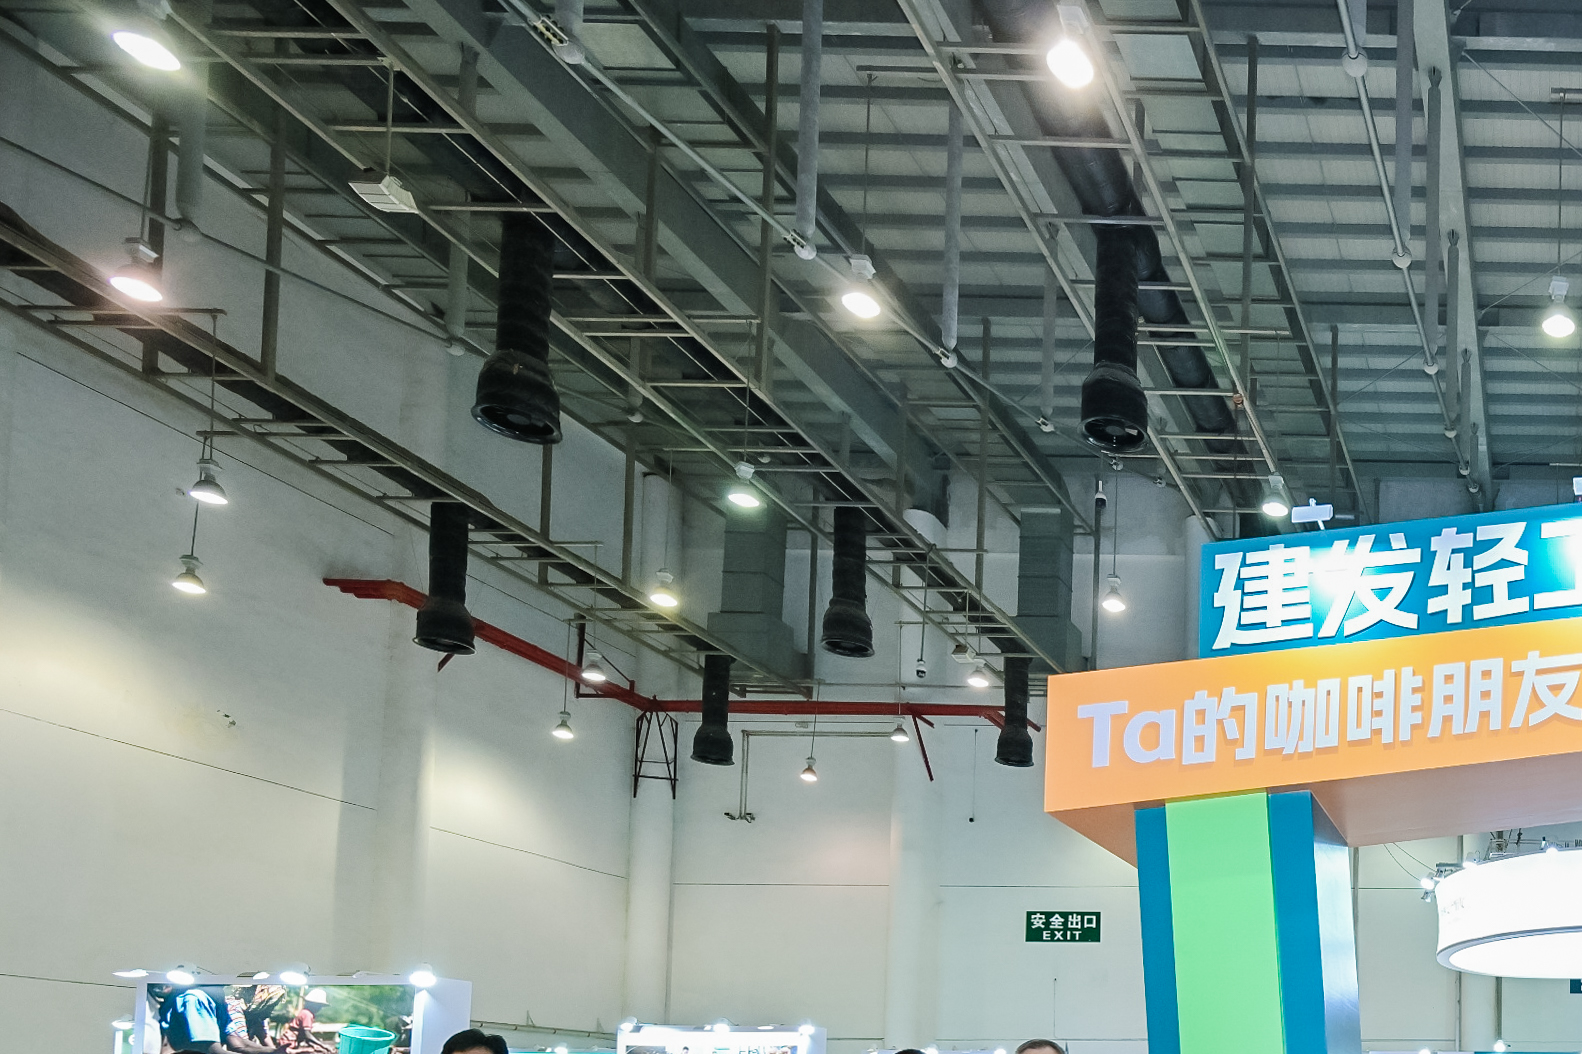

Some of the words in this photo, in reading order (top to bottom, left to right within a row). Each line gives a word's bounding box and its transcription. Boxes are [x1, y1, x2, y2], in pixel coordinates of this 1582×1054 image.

[1030, 912, 1097, 929] 安全出口
[1042, 930, 1082, 940] EXIT
